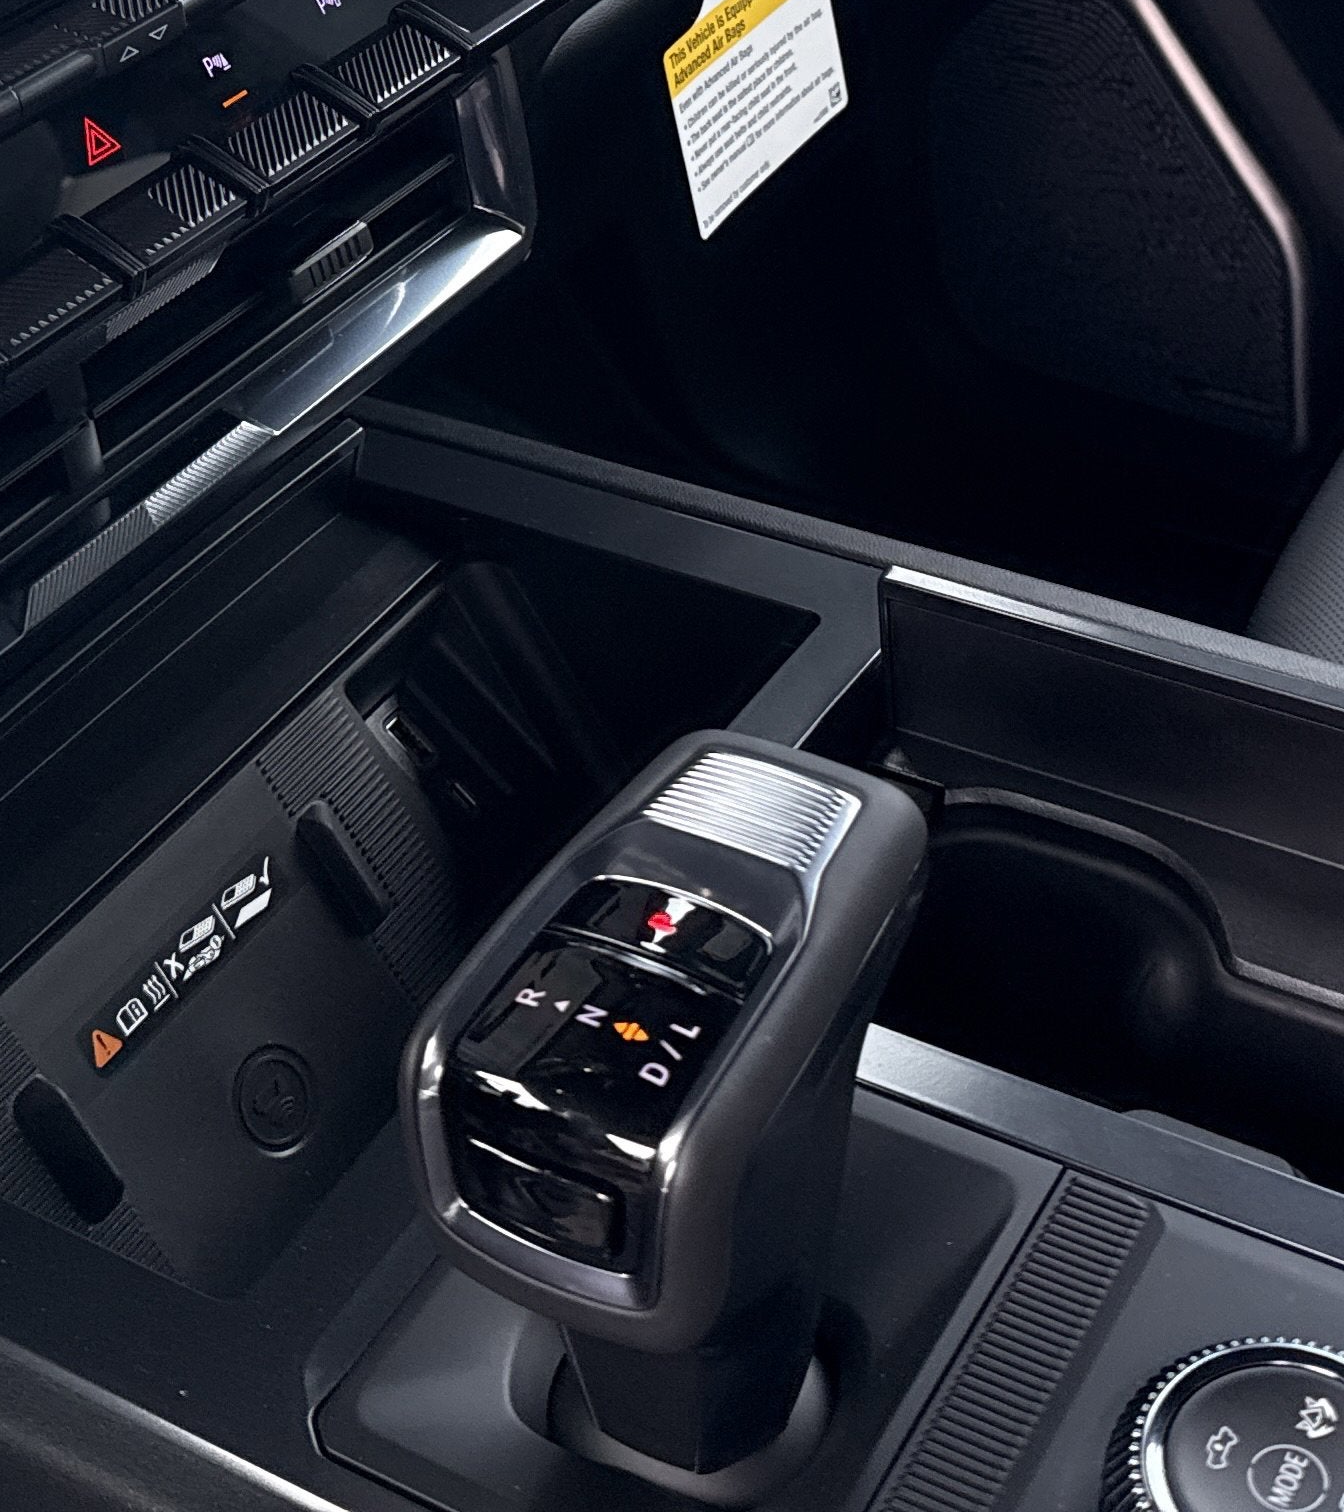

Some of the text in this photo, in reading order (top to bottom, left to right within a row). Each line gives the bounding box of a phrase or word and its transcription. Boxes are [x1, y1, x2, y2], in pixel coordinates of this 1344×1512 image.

[669, 48, 686, 68] This
[686, 23, 715, 52] Vehicle
[716, 15, 724, 29] is
[675, 20, 745, 88] Advanced Air Bags
[704, 62, 730, 89] Advanced
[515, 987, 547, 1008] R
[575, 1004, 609, 1028] N
[1268, 1451, 1309, 1507] MODE
